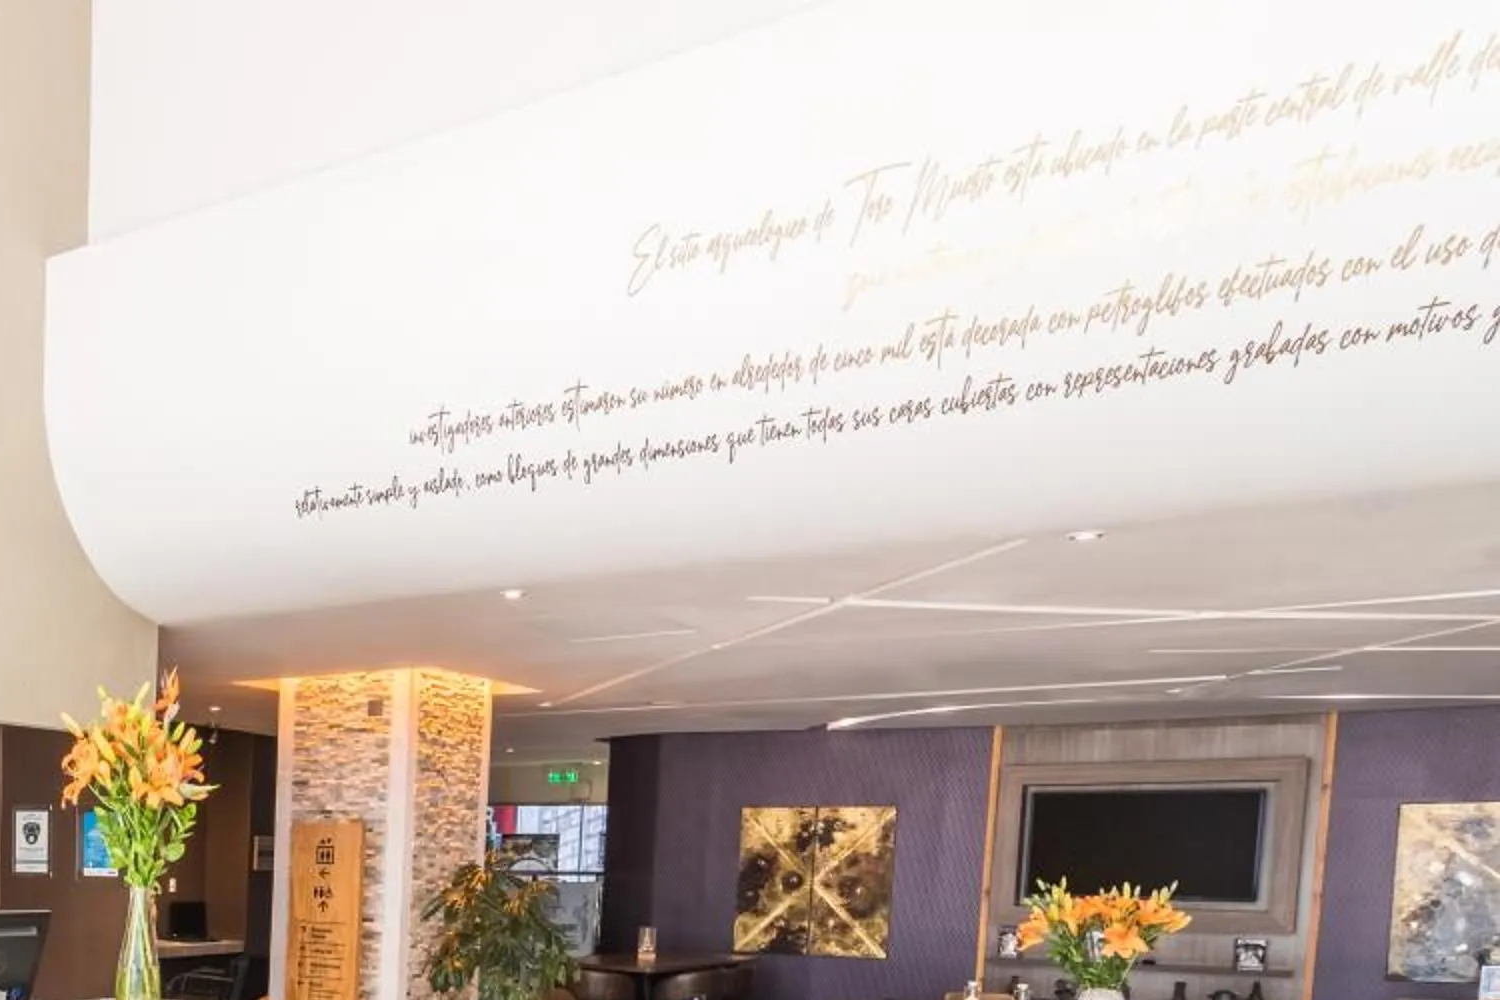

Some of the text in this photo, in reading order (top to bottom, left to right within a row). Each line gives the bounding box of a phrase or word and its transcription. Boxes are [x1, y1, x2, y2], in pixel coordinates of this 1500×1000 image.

[366, 474, 404, 506] simple
[475, 472, 501, 488] como
[507, 452, 558, 492] bloques
[563, 448, 578, 480] de
[583, 441, 634, 484] grandes
[640, 437, 719, 471] dimensiones
[726, 428, 754, 464] que
[756, 413, 802, 446] tienen
[801, 406, 846, 443] todas
[852, 408, 883, 431] sus
[889, 396, 933, 425] caras
[941, 373, 1020, 415] cubiertas
[1026, 381, 1057, 401] con
[1062, 346, 1220, 399] representaciones
[1225, 320, 1330, 385] grabadas
[1338, 327, 1381, 350] con
[1386, 295, 1482, 342] motivos
[630, 387, 647, 408] su
[710, 371, 727, 391] en
[732, 350, 804, 394] alrededor
[809, 344, 828, 385] de
[833, 350, 874, 372] cinco
[881, 322, 913, 362] mil
[962, 303, 1042, 359] decorada
[1049, 312, 1081, 334] con
[1085, 273, 1209, 336] petroglifos
[1217, 250, 1334, 304] efectuados
[1341, 253, 1382, 283] con
[1389, 222, 1426, 270] el
[1423, 232, 1474, 266] uso
